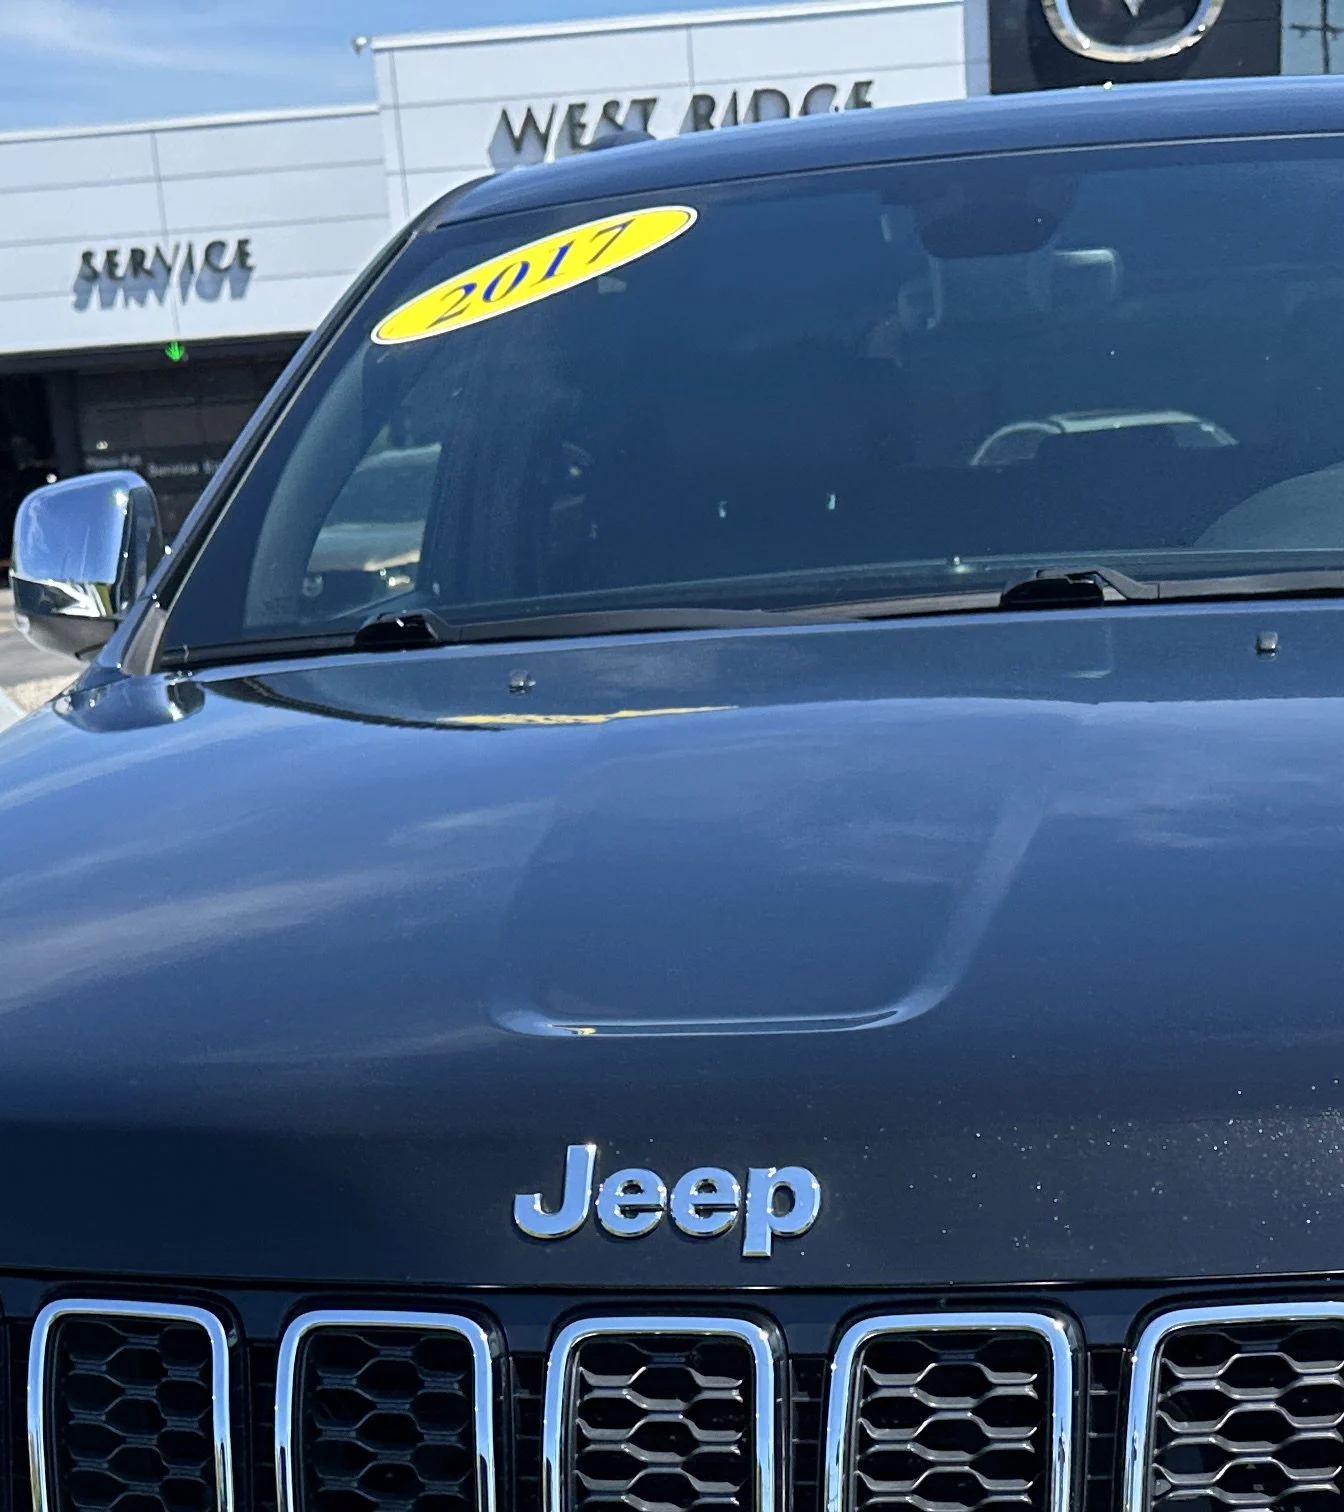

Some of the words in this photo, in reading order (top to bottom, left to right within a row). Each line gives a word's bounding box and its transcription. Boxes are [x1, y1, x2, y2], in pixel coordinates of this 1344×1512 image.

[500, 96, 659, 151] WEST
[80, 238, 256, 283] SERVICE
[425, 217, 637, 330] 2017
[513, 1143, 822, 1258] Jeep
